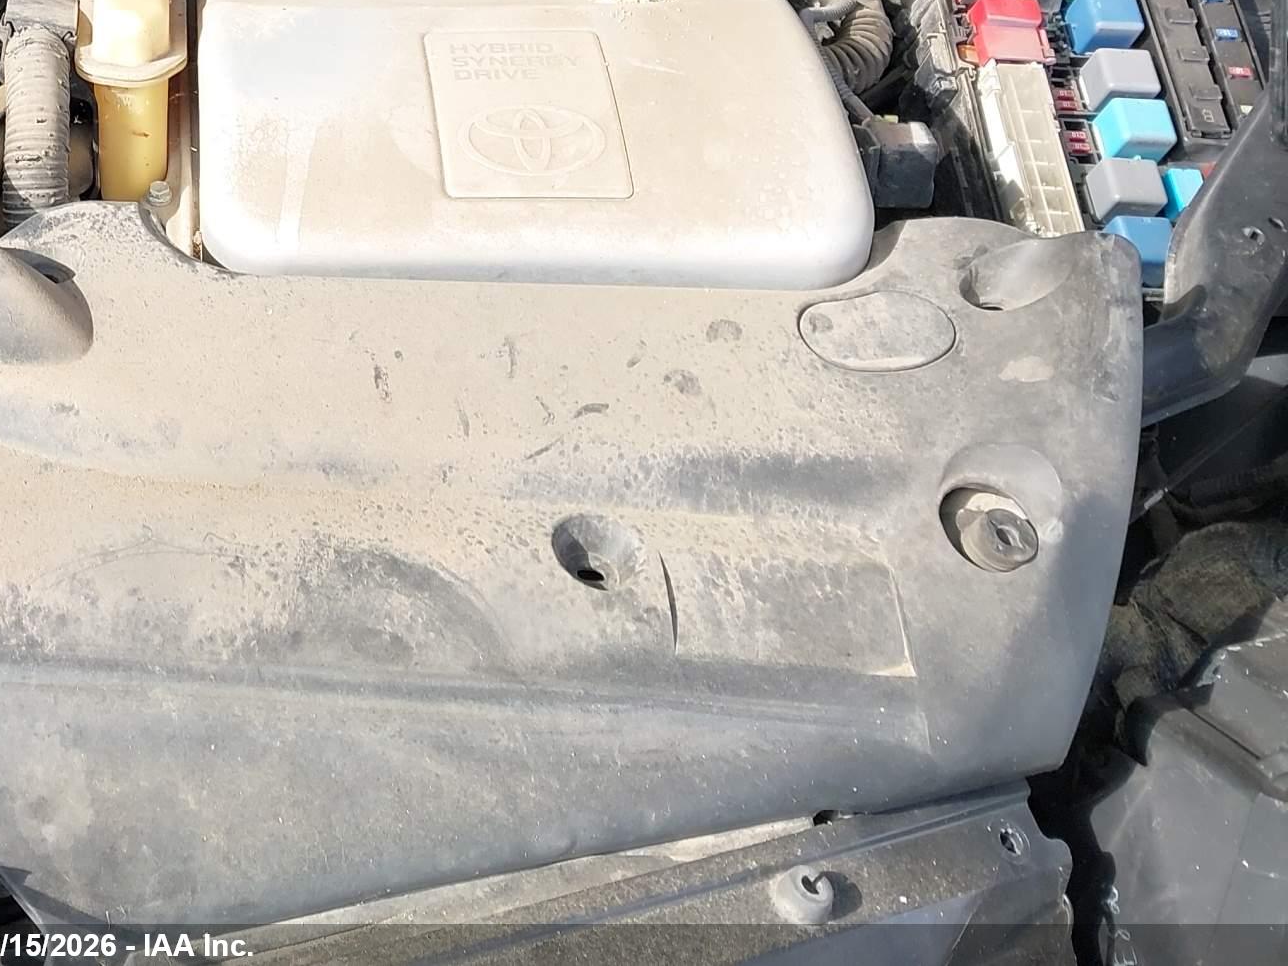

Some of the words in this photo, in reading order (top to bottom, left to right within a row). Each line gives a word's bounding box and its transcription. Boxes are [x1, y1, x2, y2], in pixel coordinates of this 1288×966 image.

[448, 42, 554, 55] HYBRID
[450, 55, 580, 67] SYNERGY
[453, 68, 540, 81] DRIVE
